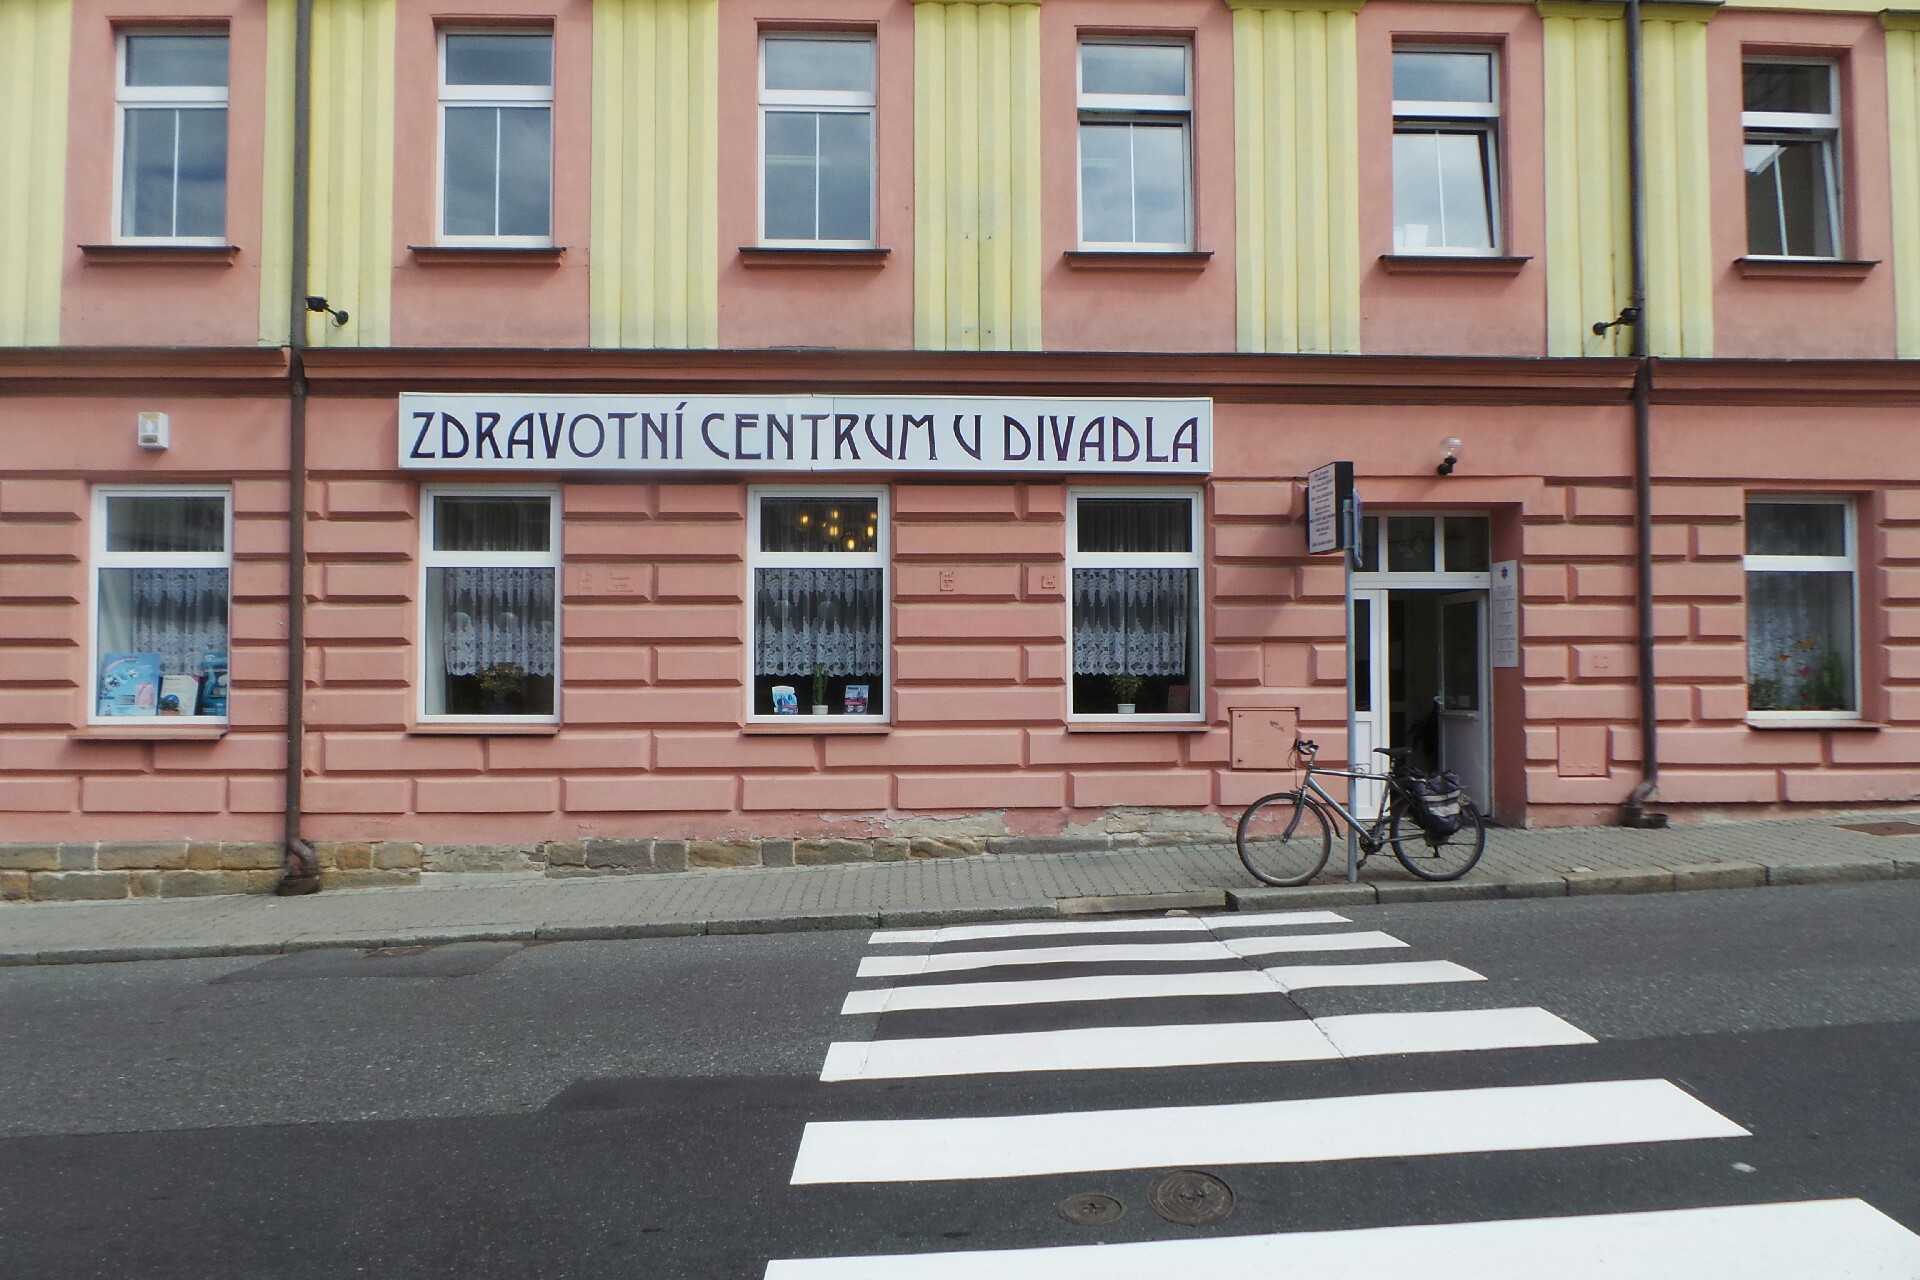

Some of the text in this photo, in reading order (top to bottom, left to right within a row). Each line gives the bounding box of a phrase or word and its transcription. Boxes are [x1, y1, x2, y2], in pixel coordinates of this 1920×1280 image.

[409, 402, 1199, 463] ZDRAVOTNÍ CENTRUM U DIVADLA
